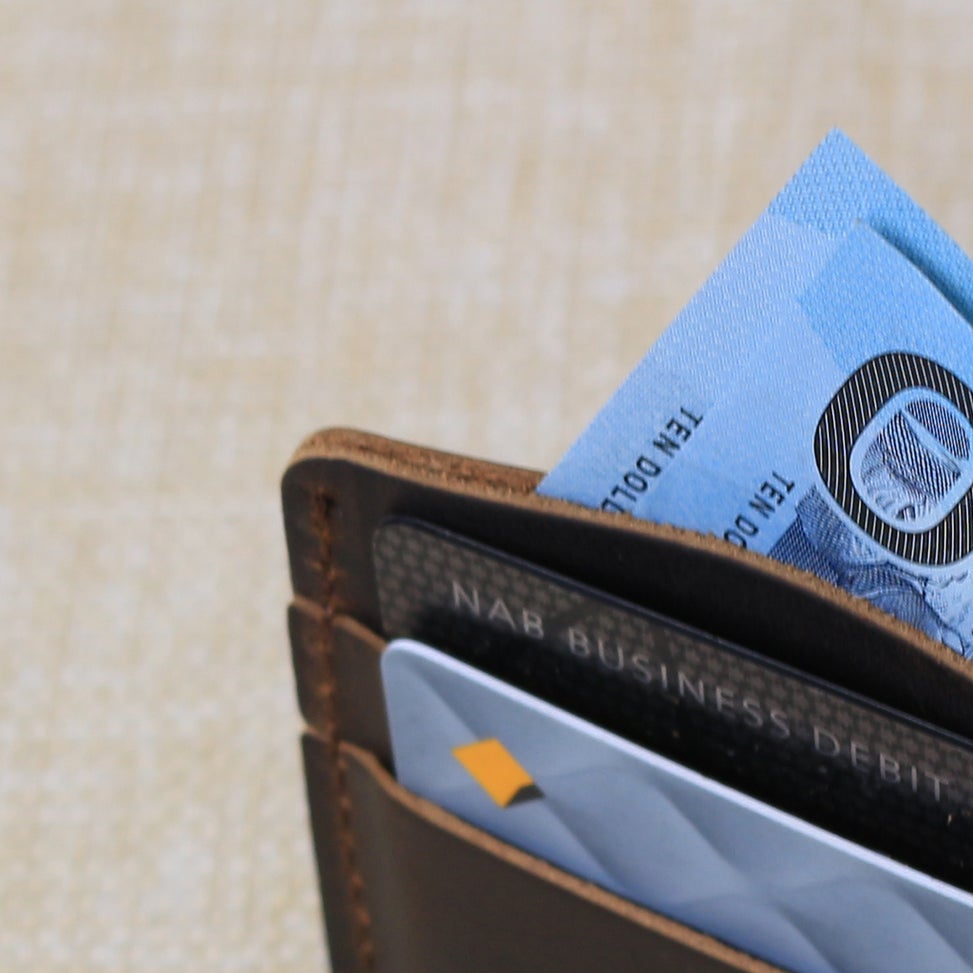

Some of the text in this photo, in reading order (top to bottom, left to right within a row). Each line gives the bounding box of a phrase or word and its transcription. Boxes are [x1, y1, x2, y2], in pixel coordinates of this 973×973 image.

[652, 407, 703, 457] TEN
[749, 470, 795, 518] TEN
[450, 580, 950, 802] NAB BUSINESS DEBIT
